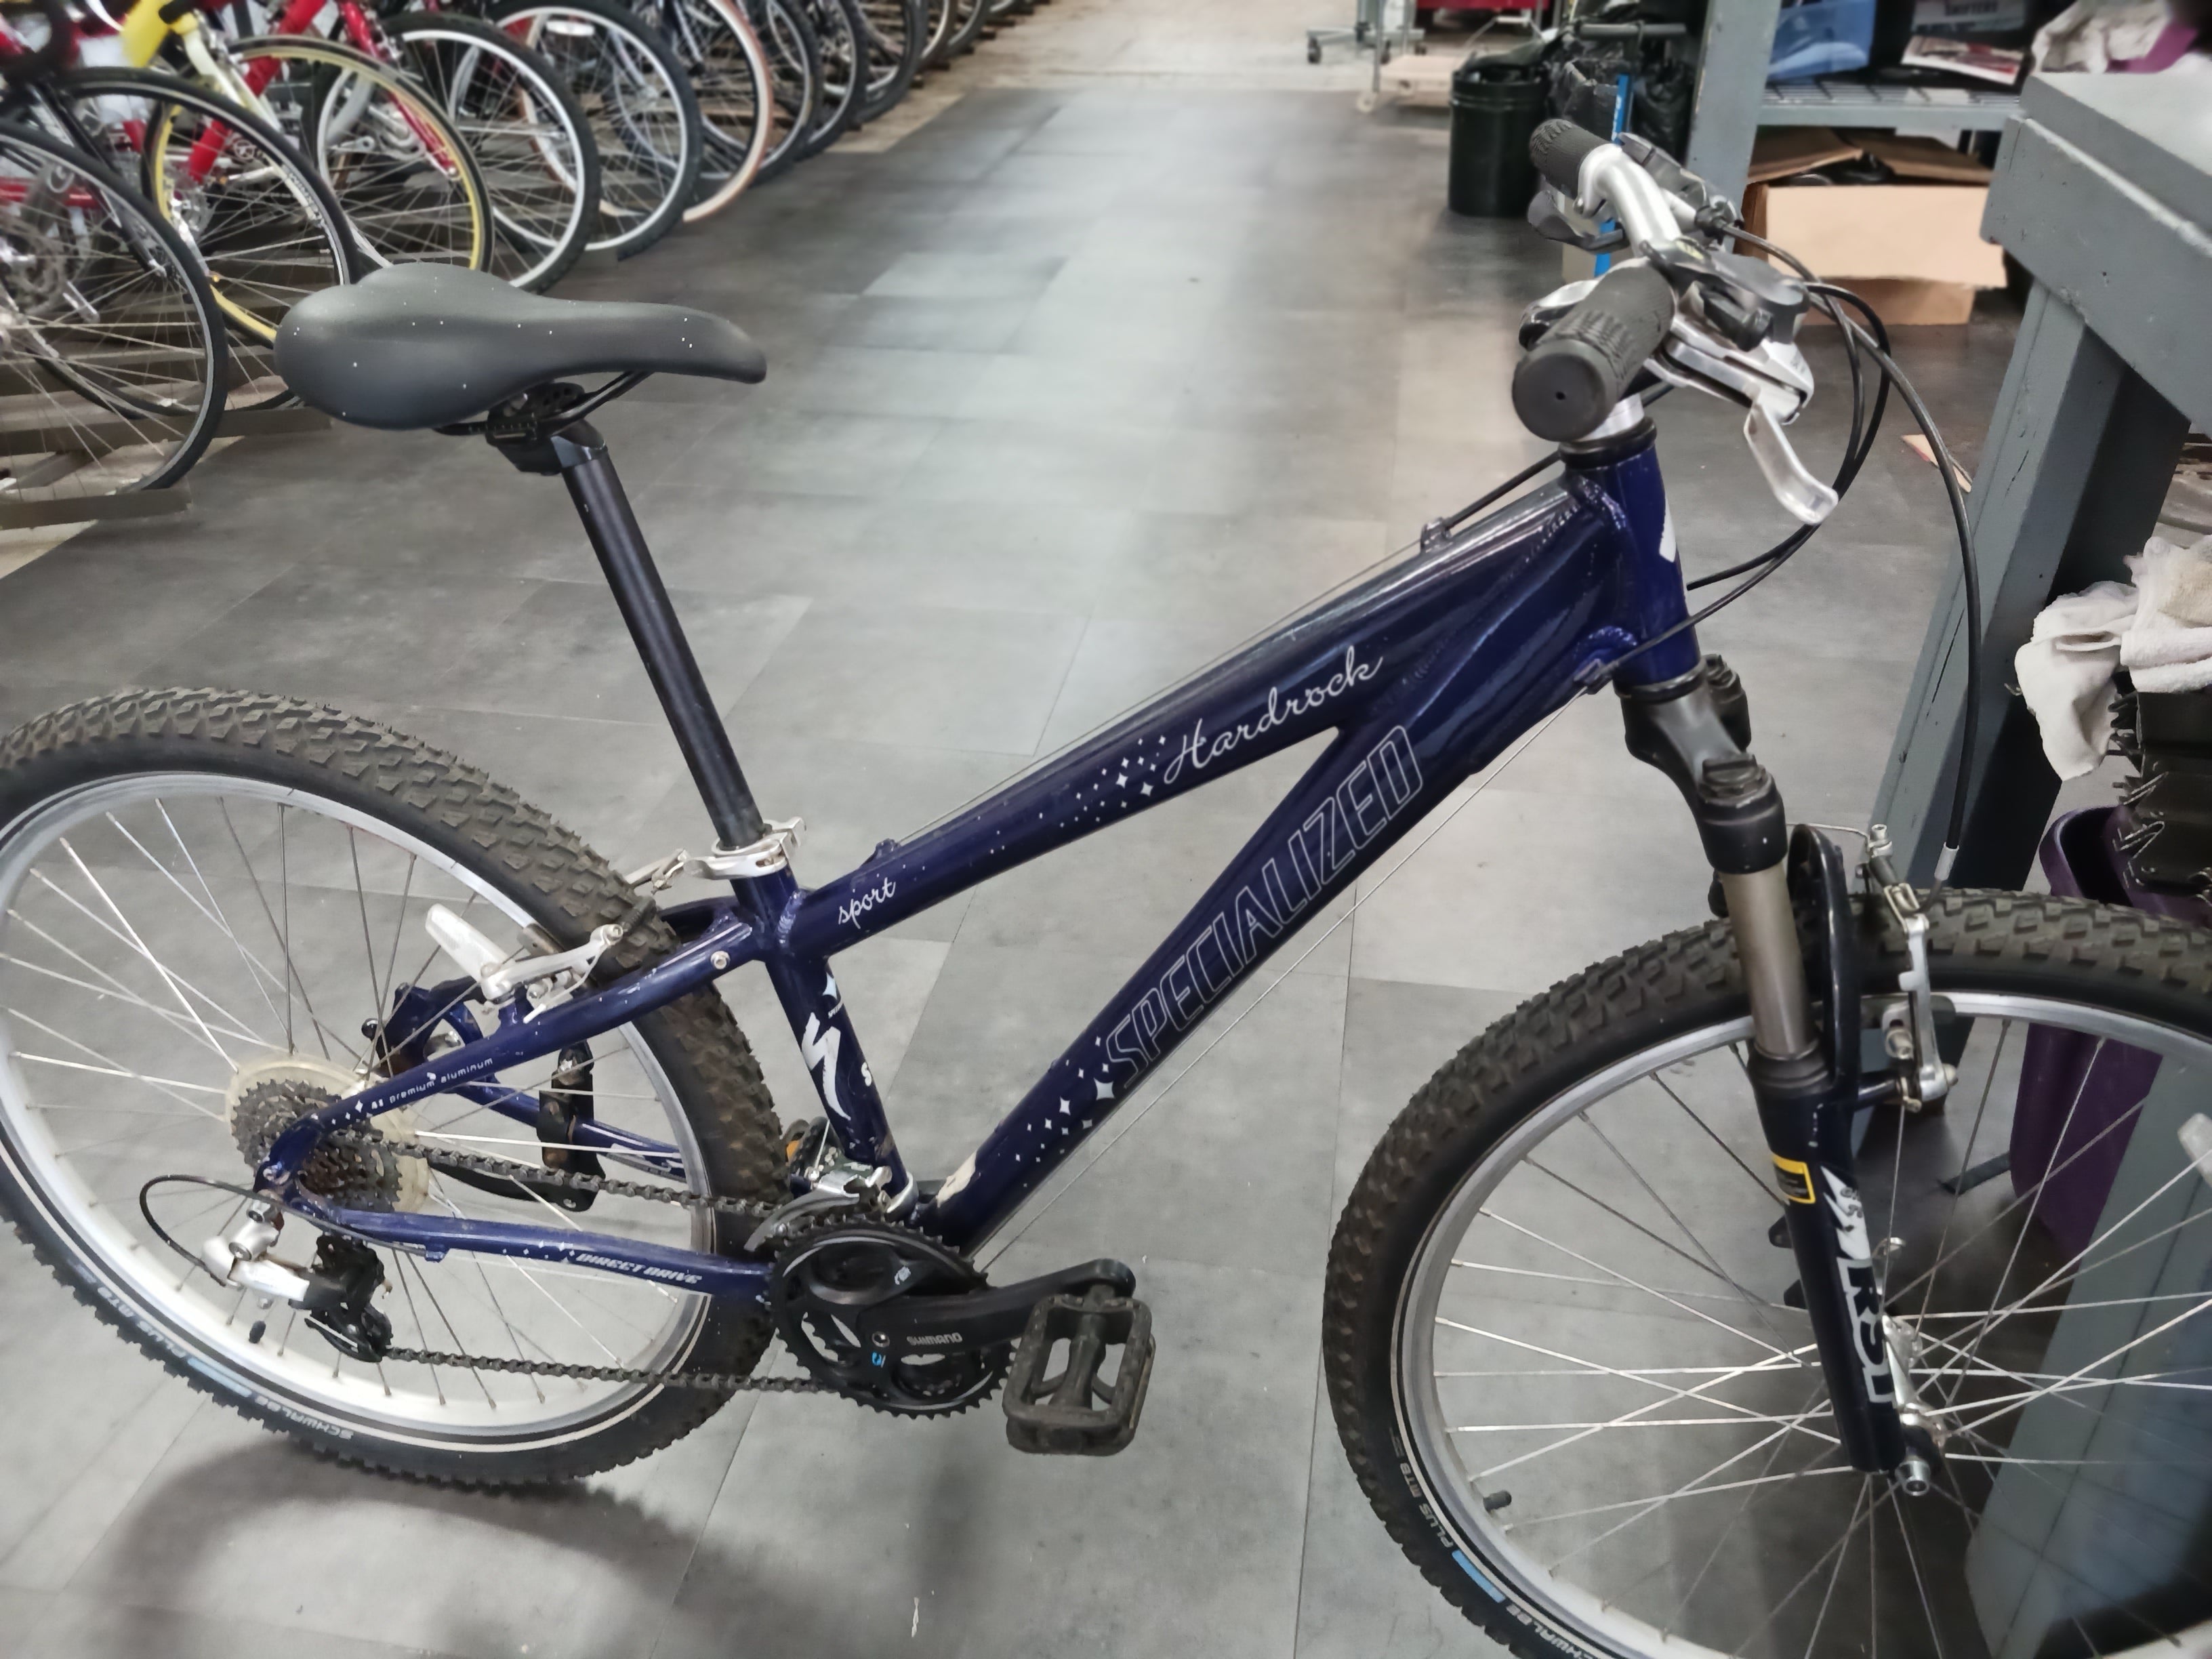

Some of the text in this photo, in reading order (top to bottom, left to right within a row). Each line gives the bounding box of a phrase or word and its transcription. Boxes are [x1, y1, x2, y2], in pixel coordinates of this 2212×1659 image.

[1164, 644, 1383, 785] Hardrock
[838, 876, 896, 929] sport
[1106, 725, 1423, 1089] SPECIALIZED
[389, 1080, 434, 1104] premium
[441, 1057, 493, 1083] aluminum
[576, 1253, 703, 1284] DIRECT DRIVE
[137, 1320, 186, 1358] PLUS
[906, 1332, 963, 1346] SHIMANO
[254, 1395, 354, 1440] SCHWALBE
[1400, 1462, 1422, 1498] MTB
[1419, 1502, 1454, 1548] PLUS
